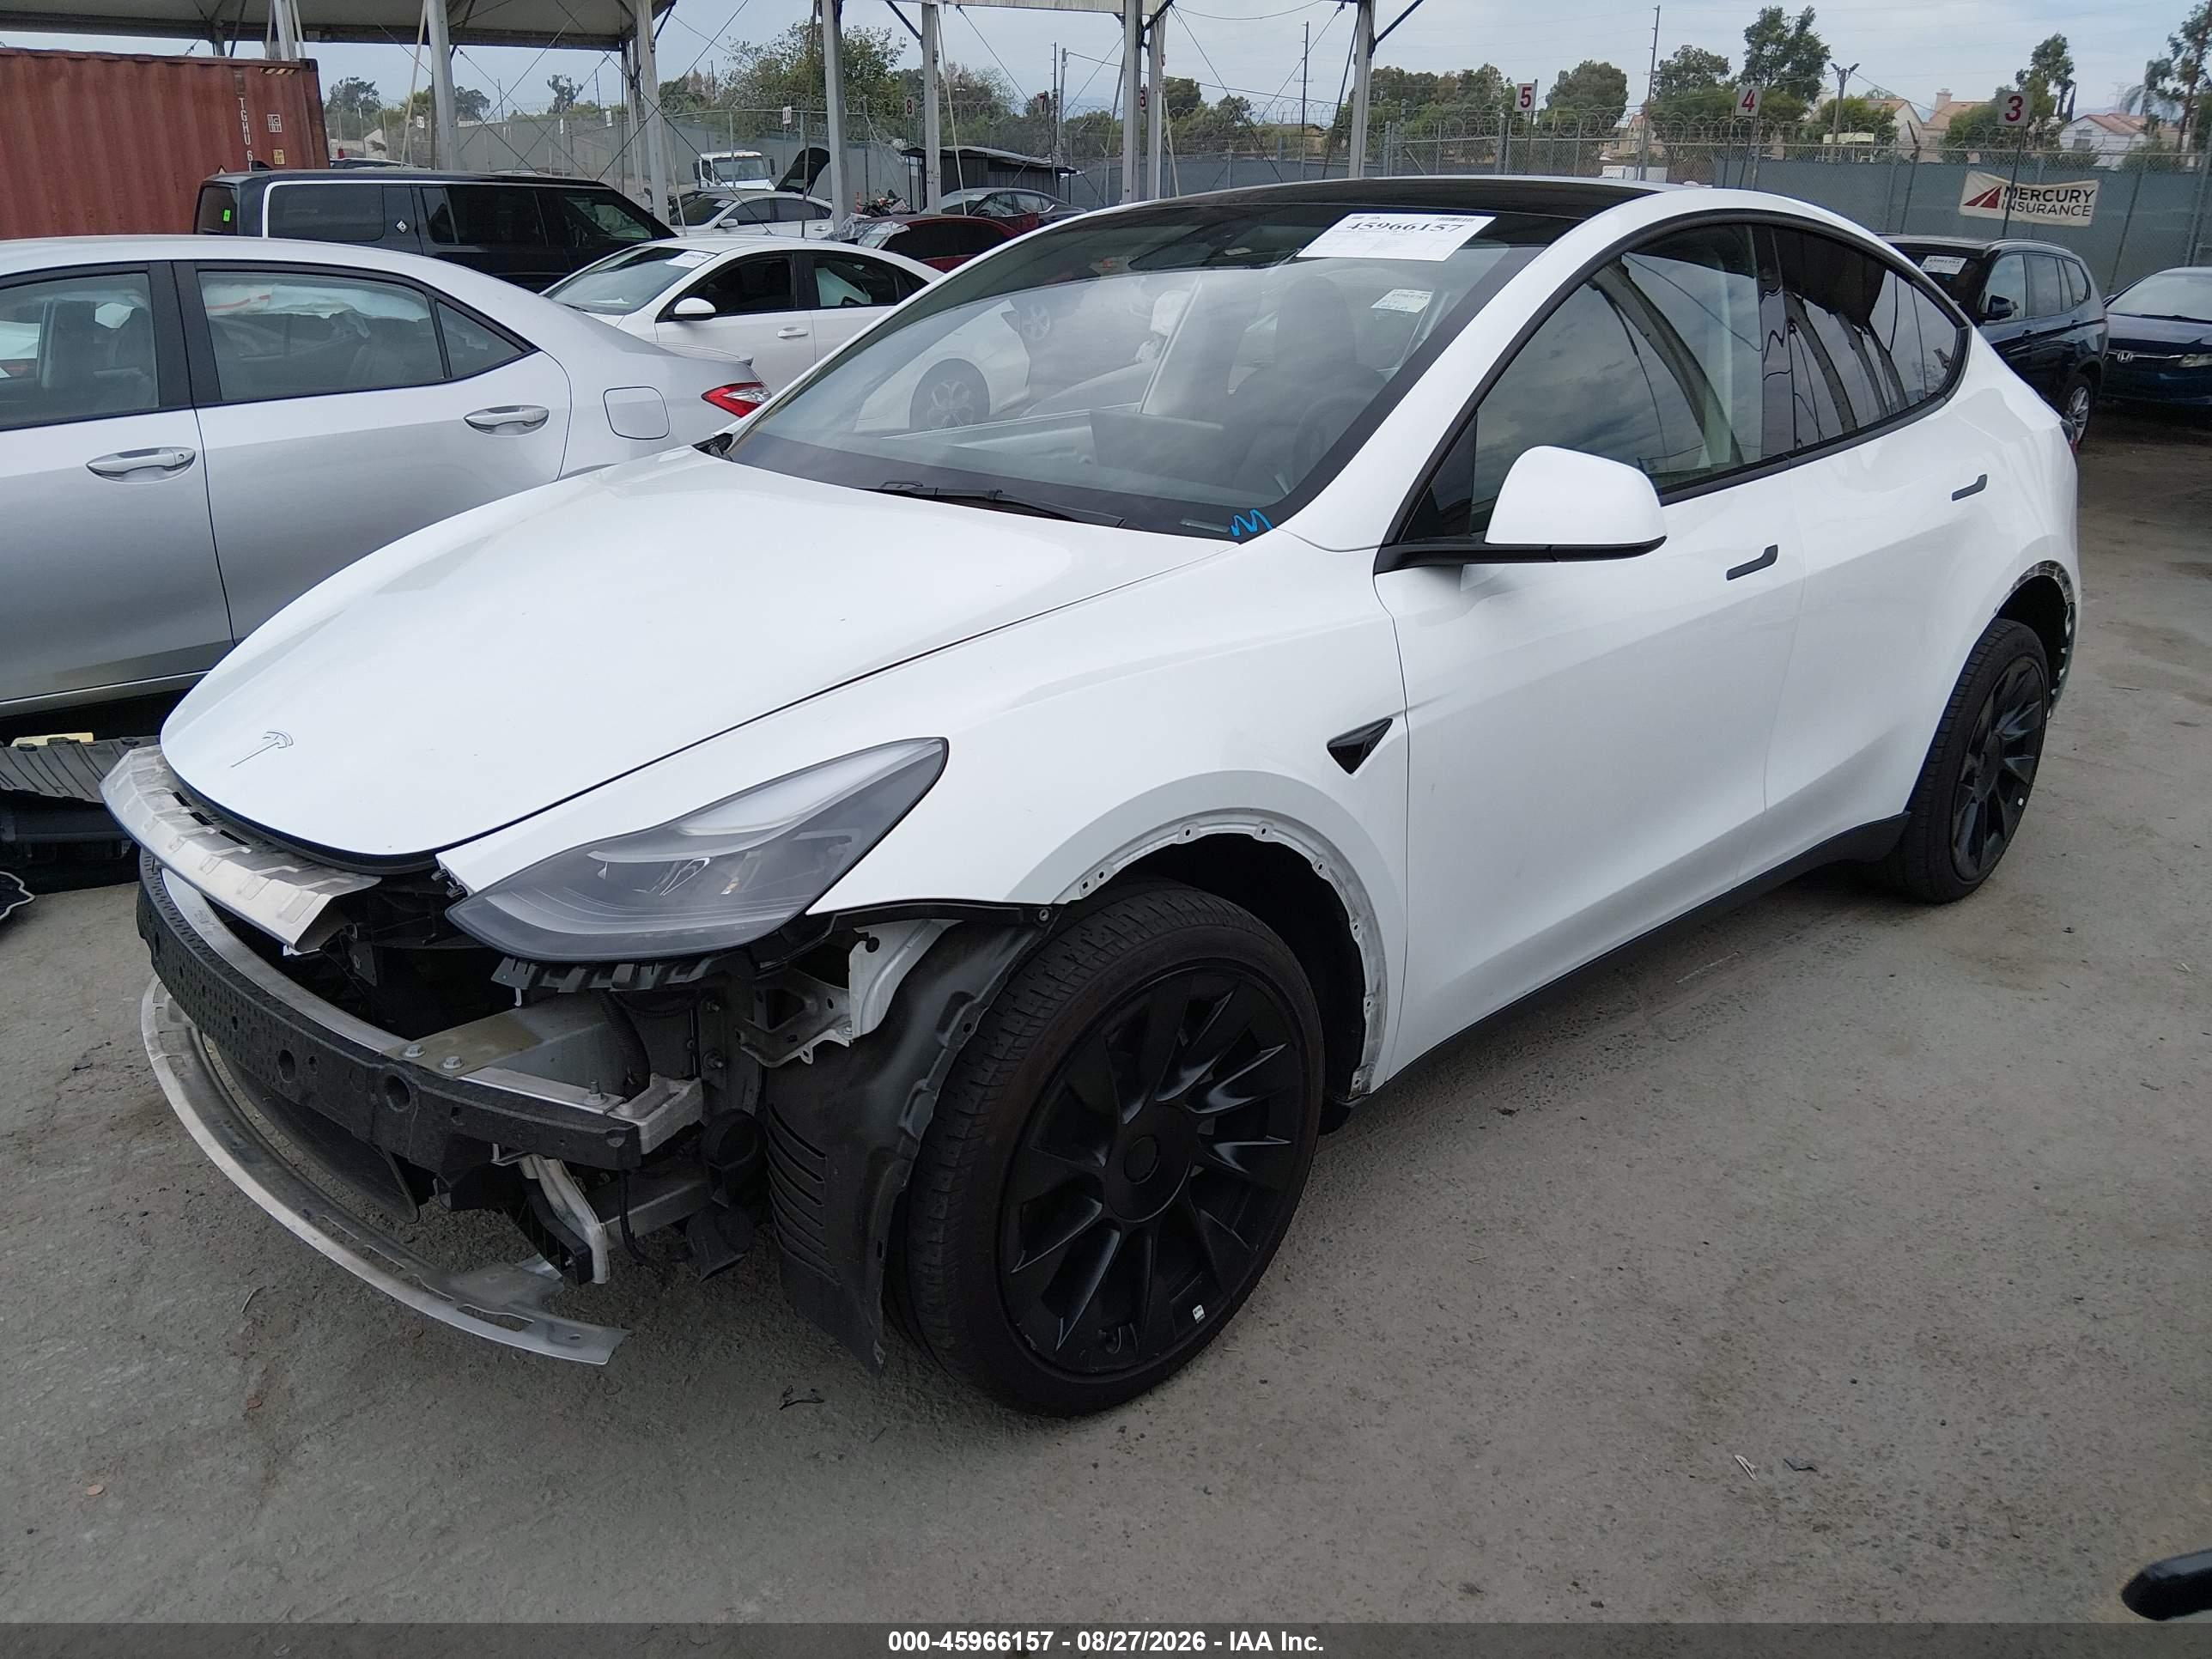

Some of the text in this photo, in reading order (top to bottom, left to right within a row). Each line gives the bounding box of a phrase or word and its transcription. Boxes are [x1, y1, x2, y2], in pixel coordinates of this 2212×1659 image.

[1039, 95, 1046, 112] 7
[1520, 87, 1532, 108] 5
[1741, 89, 1755, 112] 4
[782, 109, 792, 122] 10
[906, 99, 914, 115] 8
[2005, 95, 2024, 122] 3
[238, 97, 252, 145] TGHU
[2004, 186, 2095, 203] MERCURY
[2001, 199, 2092, 216] INSURANCE
[1346, 222, 1465, 233] 45966157
